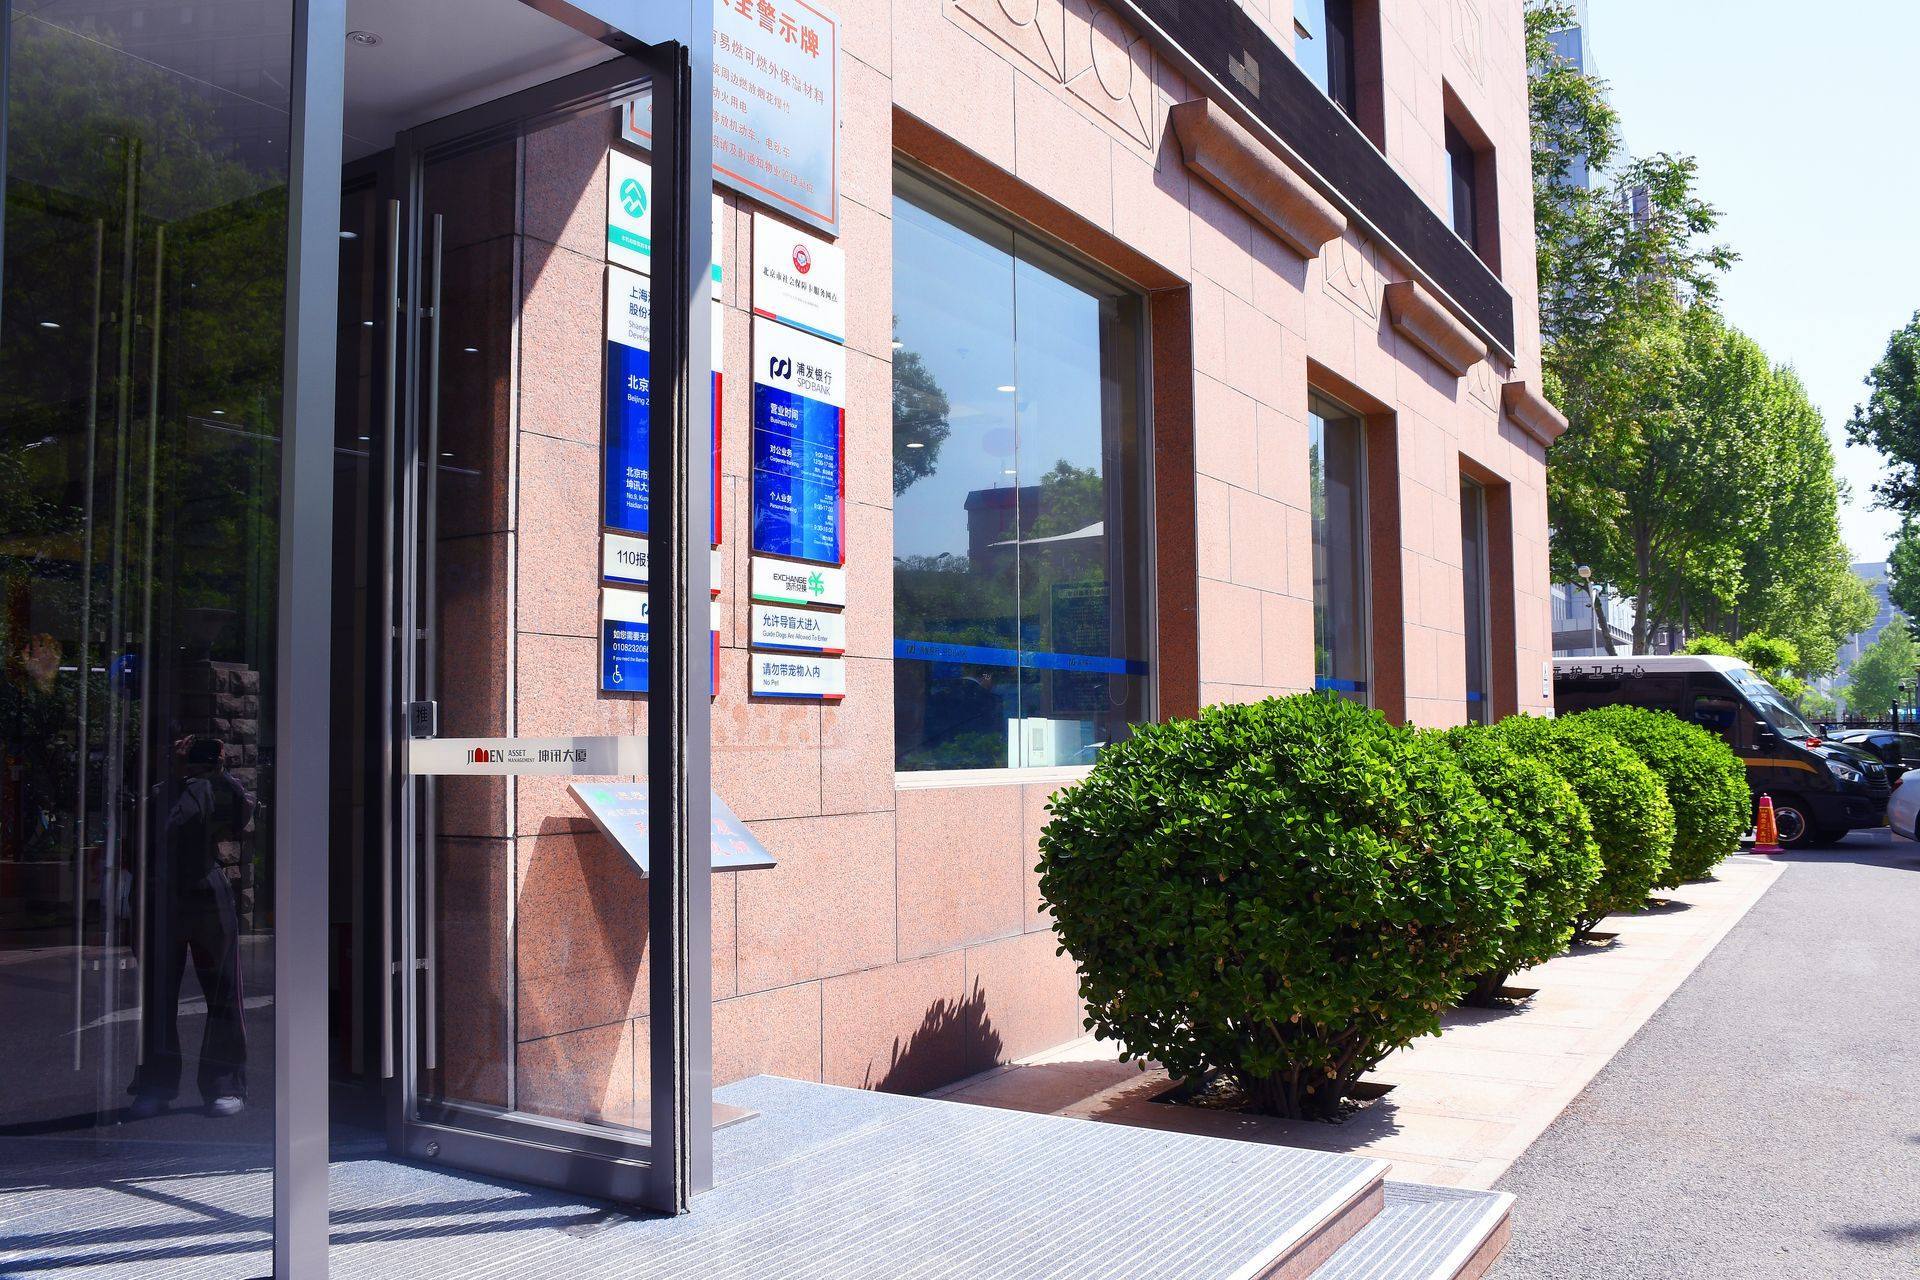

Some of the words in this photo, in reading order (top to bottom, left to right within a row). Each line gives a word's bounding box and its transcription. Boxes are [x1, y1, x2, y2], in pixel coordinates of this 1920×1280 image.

[721, 0, 819, 58] 全警示牌
[629, 286, 650, 303] 上海
[629, 302, 650, 319] 股份
[627, 374, 649, 392] 北京
[796, 362, 832, 396] 浦发银行
[770, 403, 799, 421] 营业时间
[770, 491, 793, 504] 个人业务
[617, 550, 649, 567] 110报
[773, 573, 807, 585] EXCHANGE
[763, 613, 821, 631] 允许导盲犬进入
[613, 629, 649, 642] 如您需要无
[763, 630, 775, 638] Guide
[776, 631, 787, 640] Dogs
[613, 642, 649, 654] 010823206
[763, 662, 820, 678] 请勿带宠物入内
[416, 705, 428, 724] 推
[538, 748, 587, 763] 坤讯大厦
